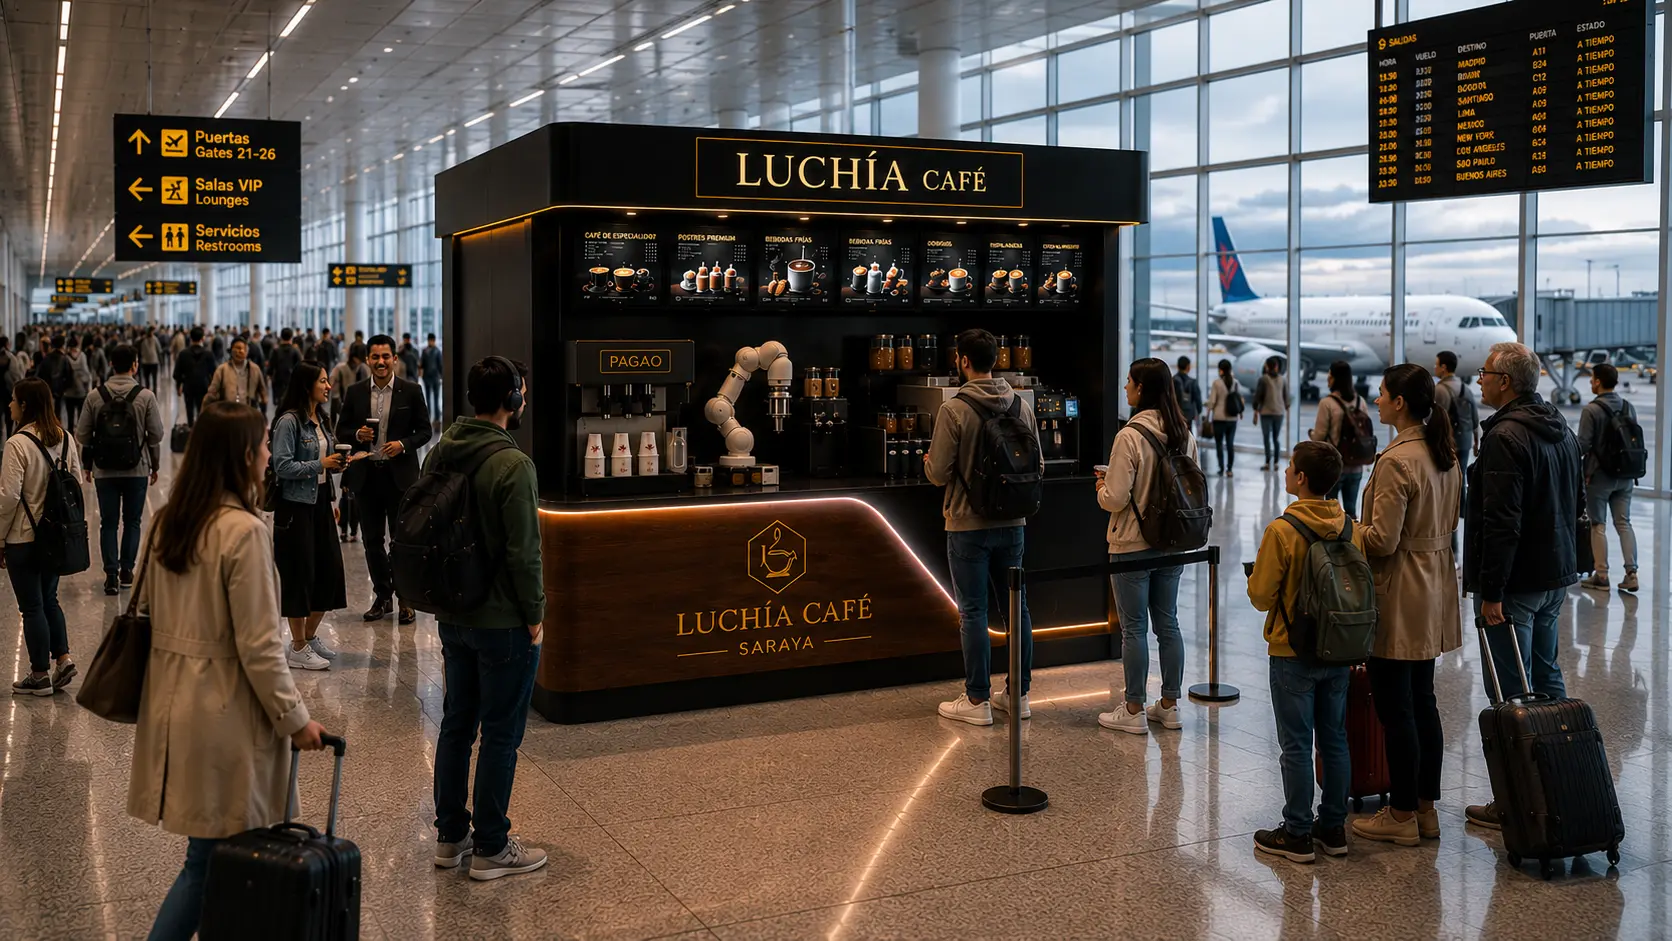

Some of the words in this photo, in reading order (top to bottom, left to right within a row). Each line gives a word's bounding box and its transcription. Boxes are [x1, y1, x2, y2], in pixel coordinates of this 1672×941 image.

[1416, 51, 1436, 60] VUELO
[1458, 42, 1486, 53] DESTINO
[1577, 21, 1605, 32] ESTADO
[1577, 41, 1584, 49] A
[1577, 54, 1583, 62] A
[1533, 73, 1546, 81] C12
[1577, 68, 1583, 76] A
[1577, 82, 1583, 90] A
[1577, 95, 1583, 103] A
[196, 130, 249, 144] Puertas
[196, 146, 233, 158] Gates
[238, 148, 276, 160] 21-26
[737, 151, 908, 191] LUCHÍA
[923, 167, 986, 191] CAFÉ
[196, 178, 233, 191] Salas
[238, 179, 262, 191] VIP
[196, 194, 249, 208] Lounges
[196, 224, 260, 237] Servicios
[196, 240, 261, 252] Restrooms
[610, 356, 662, 367] PAGAO
[677, 600, 793, 636] LUCHÍA
[803, 593, 872, 624] CAFÉ
[740, 636, 813, 655] SARAYA
